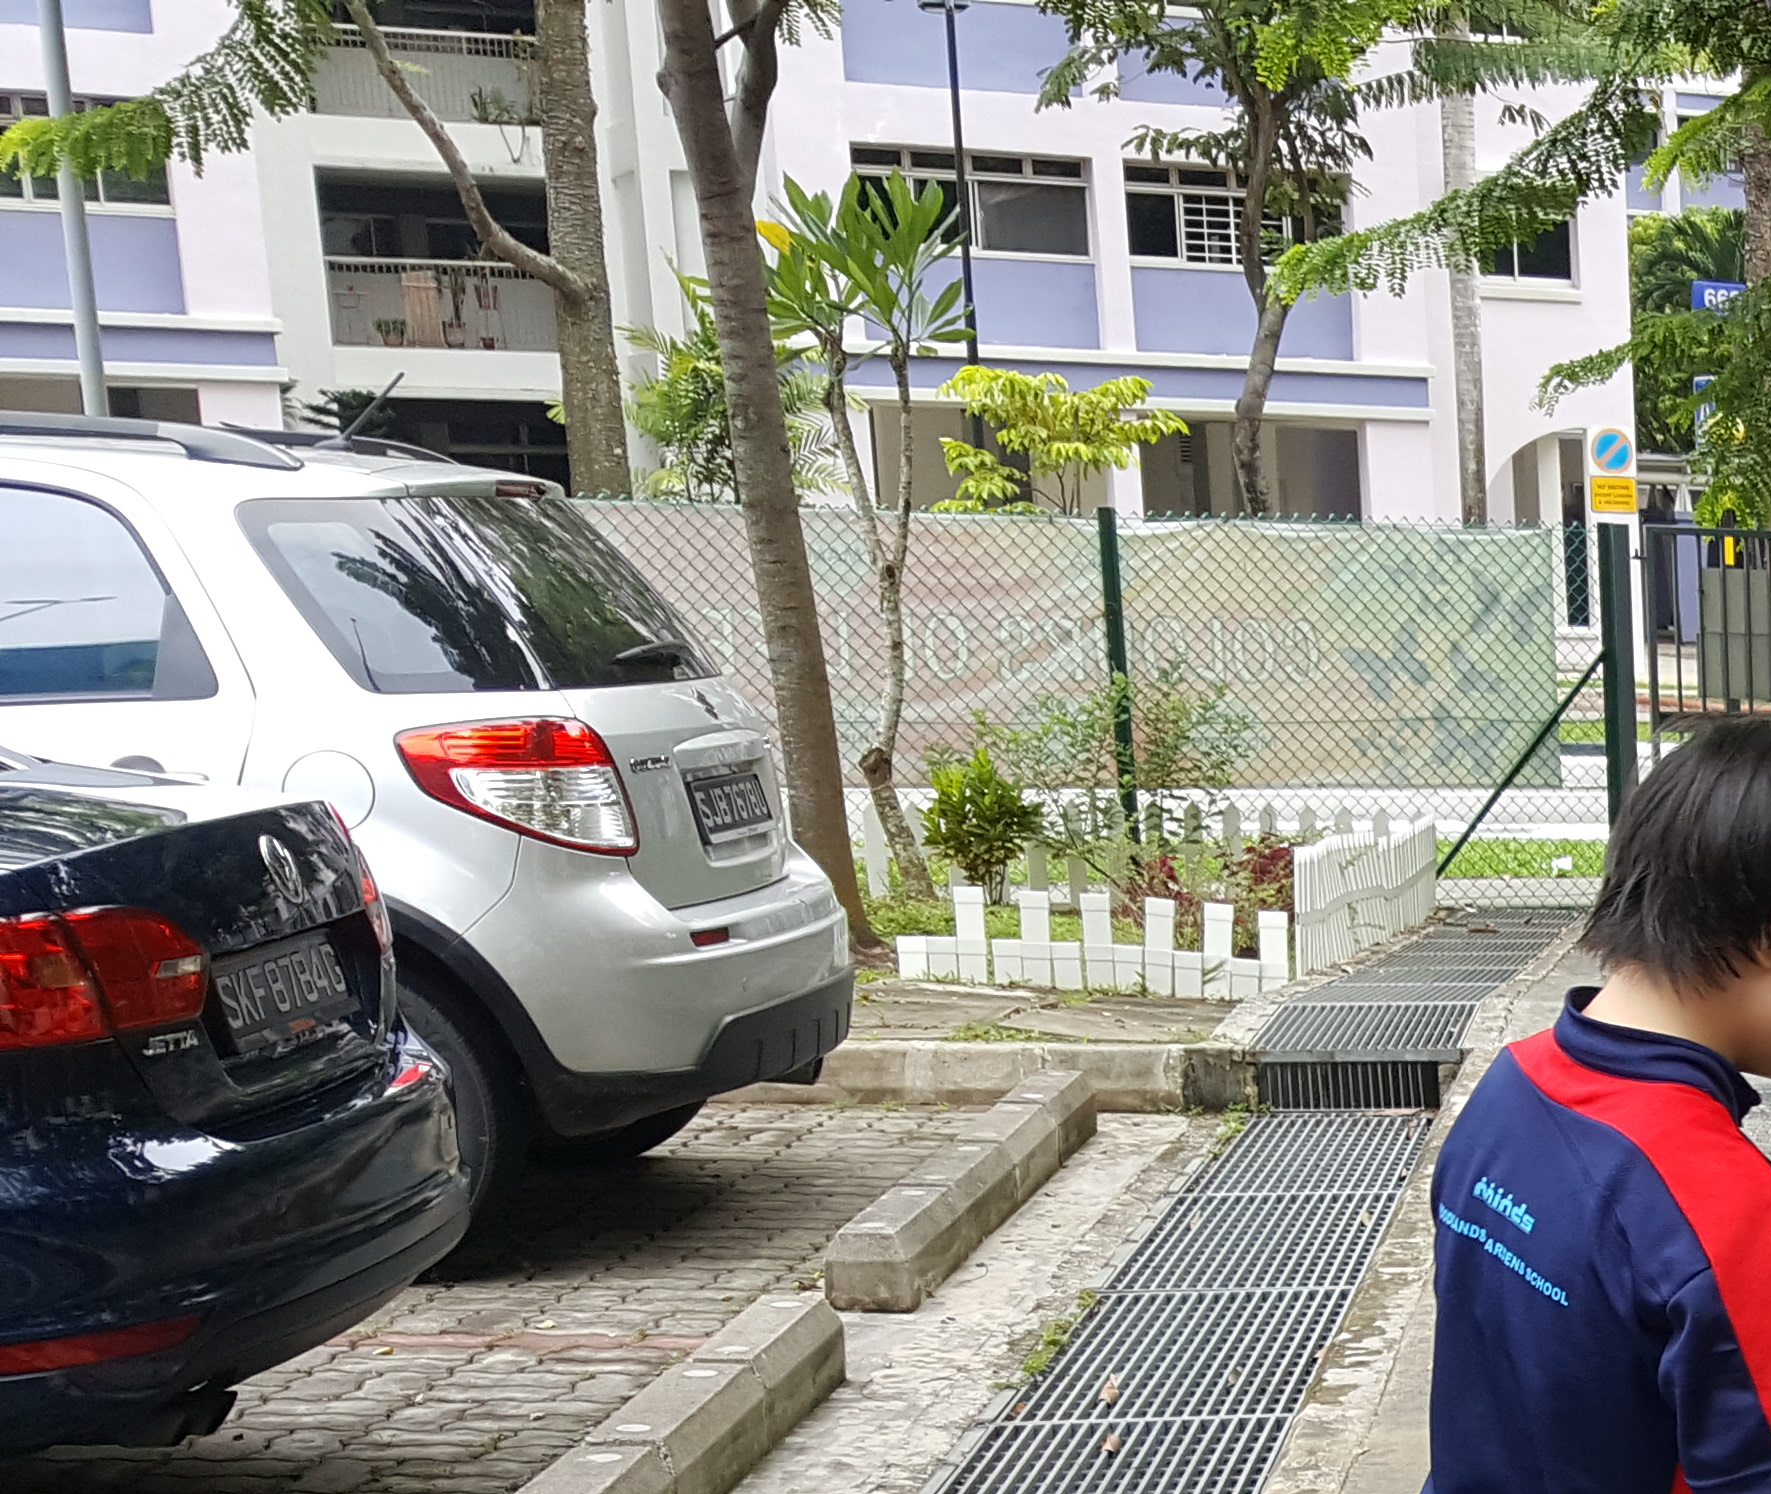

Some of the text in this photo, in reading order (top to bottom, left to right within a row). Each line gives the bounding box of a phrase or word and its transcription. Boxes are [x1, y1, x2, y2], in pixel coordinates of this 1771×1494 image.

[1704, 288, 1741, 312] 66
[694, 780, 768, 828] SJB7678U
[142, 1030, 199, 1056] JETTA
[1525, 1267, 1569, 1306] SCHOOL
